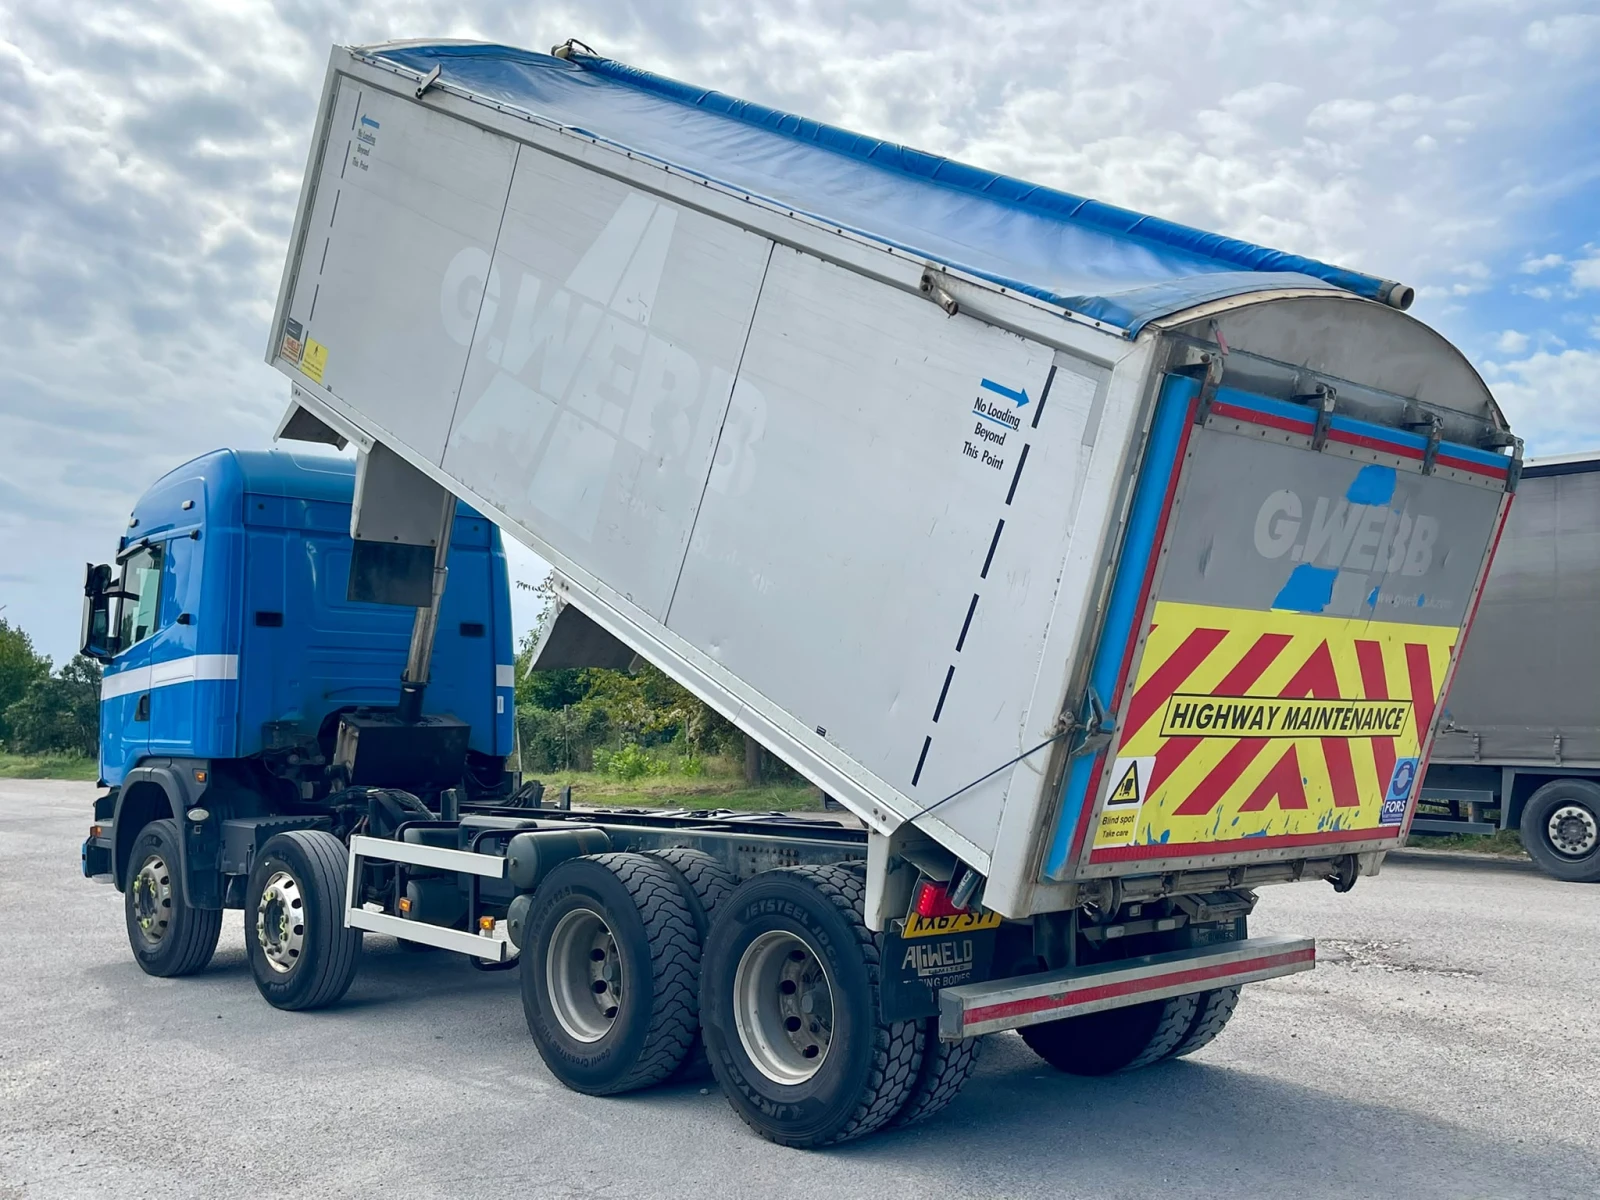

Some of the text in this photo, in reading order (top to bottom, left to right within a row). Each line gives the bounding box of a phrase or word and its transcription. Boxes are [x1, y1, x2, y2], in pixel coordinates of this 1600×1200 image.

[974, 396, 1021, 431] No Loading
[974, 421, 1007, 446] Beyond
[963, 441, 1004, 470] This Point
[1253, 489, 1439, 577] G.WEBB
[1169, 703, 1405, 730] HIGHWAY MAINTENANCE
[1102, 815, 1135, 825] Blind spot
[1384, 800, 1406, 813] FORS
[1102, 830, 1115, 838] Take
[745, 899, 809, 925] JETSTEEL
[811, 926, 837, 957] JDC
